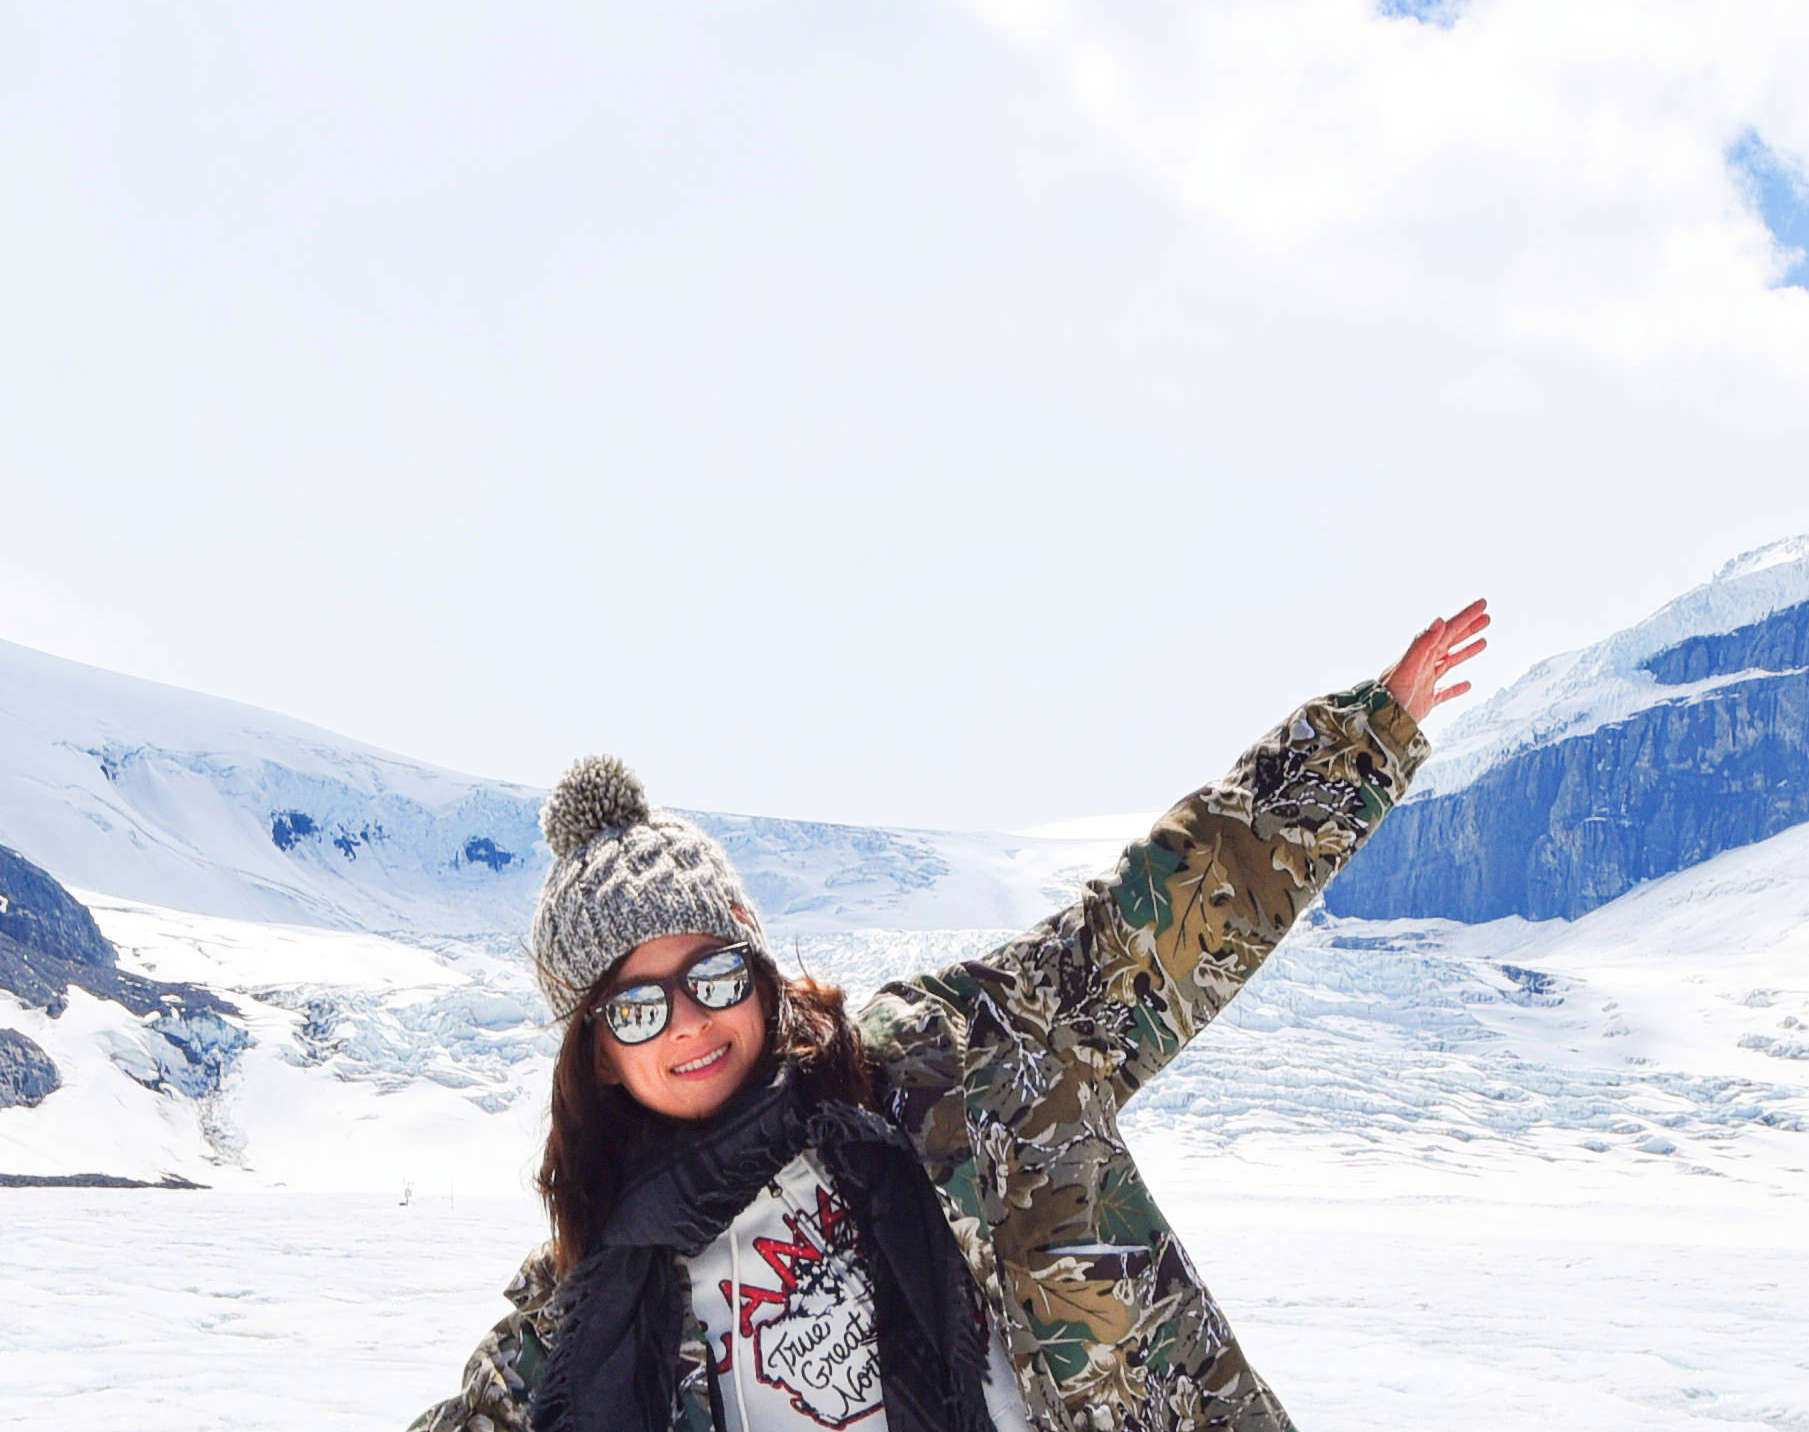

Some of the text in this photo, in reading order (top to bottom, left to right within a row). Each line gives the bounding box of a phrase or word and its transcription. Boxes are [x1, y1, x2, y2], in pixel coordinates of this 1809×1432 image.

[698, 1184, 849, 1374] ANA
[767, 1321, 831, 1377] True
[801, 1311, 866, 1389] Great
[832, 1349, 882, 1418] Nort
